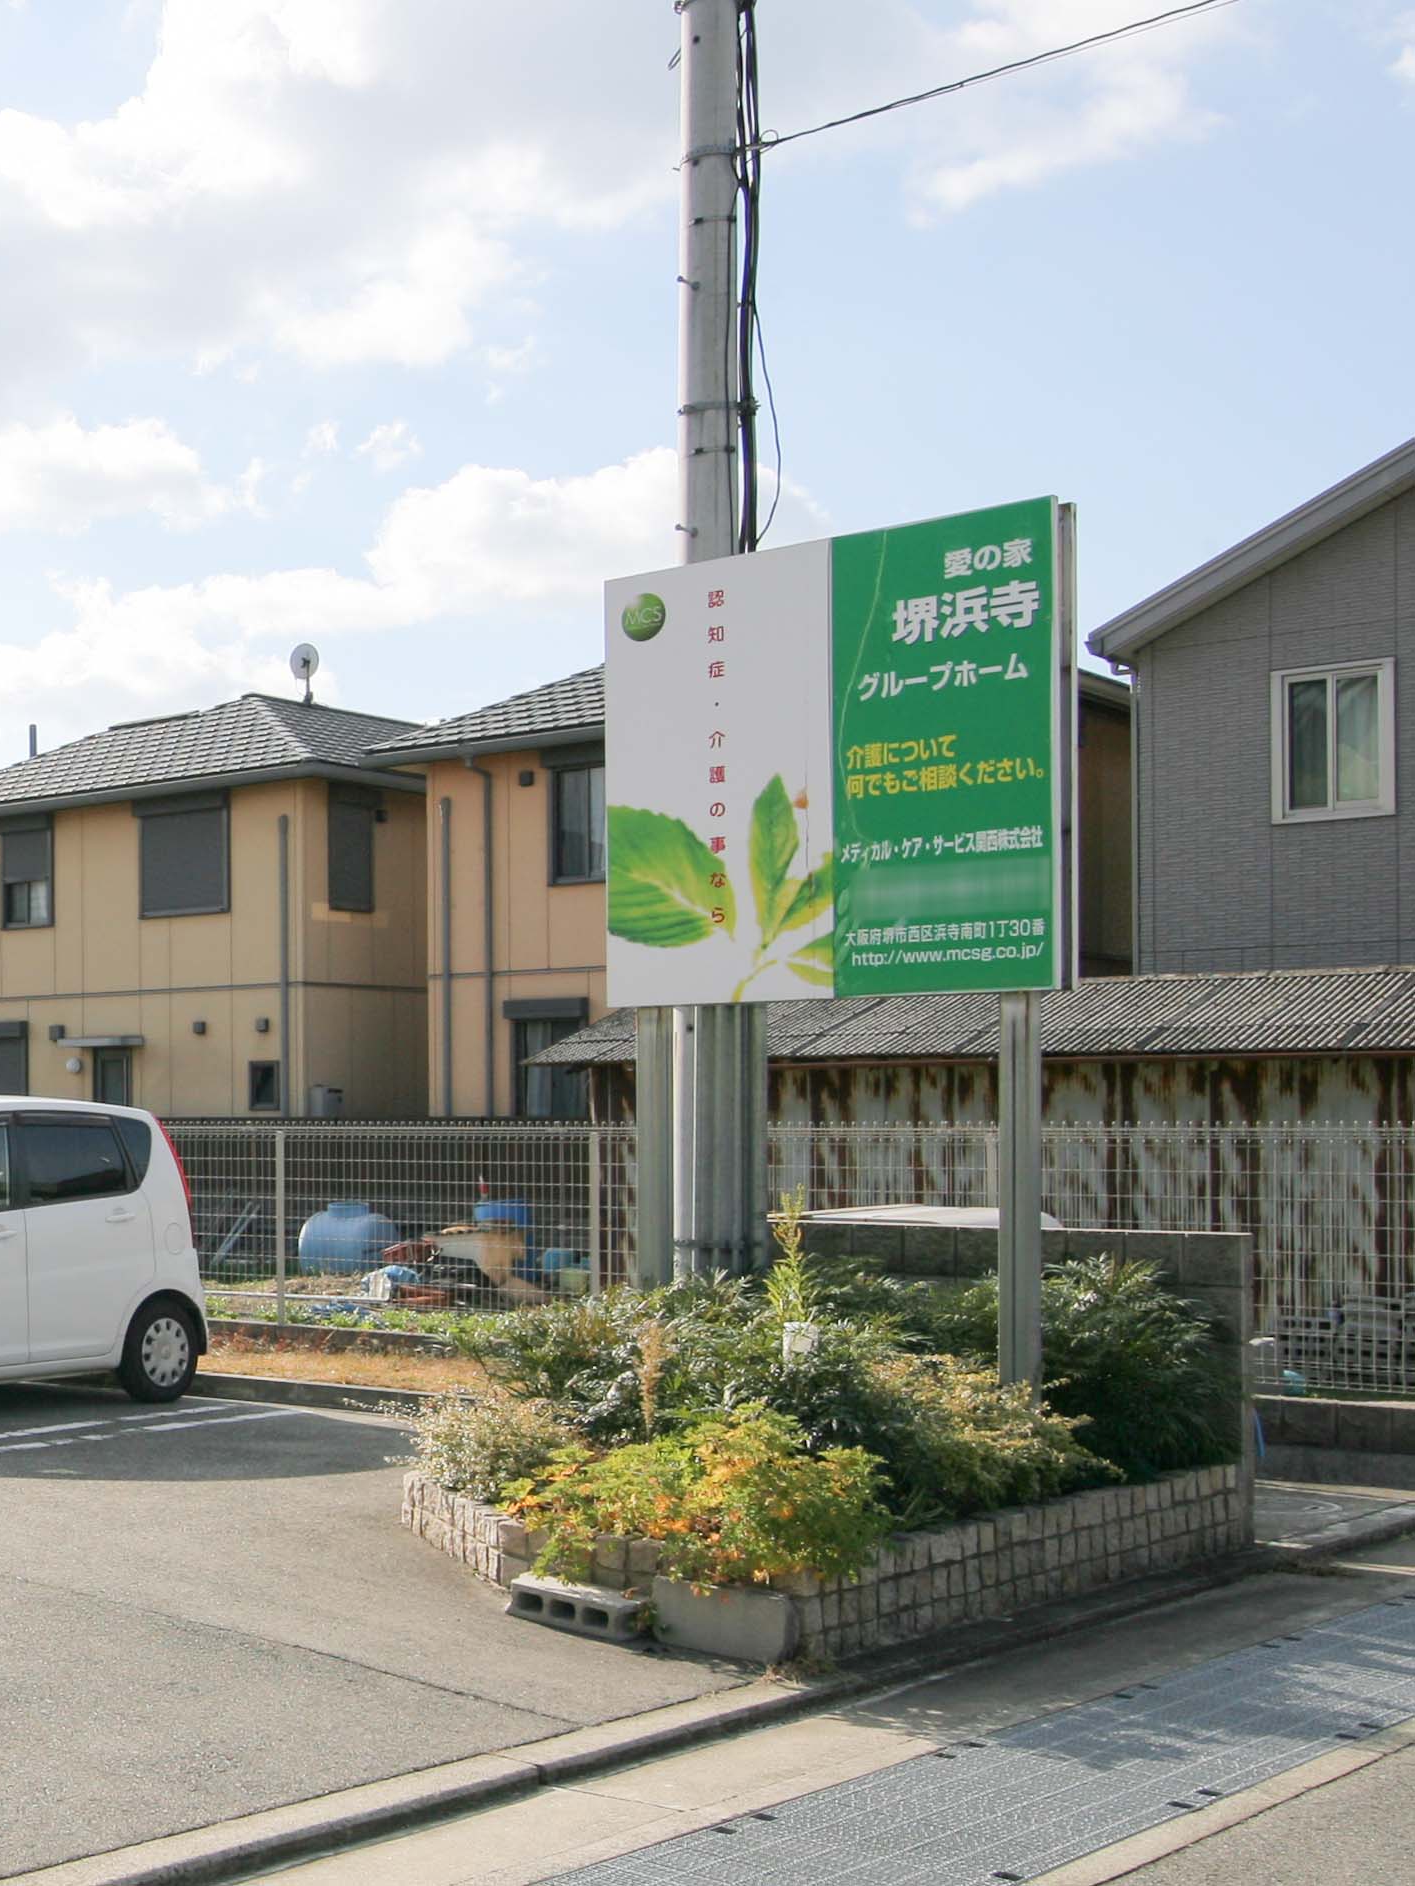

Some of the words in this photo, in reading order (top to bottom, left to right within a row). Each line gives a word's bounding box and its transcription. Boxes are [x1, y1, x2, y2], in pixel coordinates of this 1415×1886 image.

[944, 538, 1033, 579] 愛の家
[625, 606, 663, 626] MCS
[892, 580, 1040, 645] 堺浜寺
[857, 652, 1029, 702] グループホーム
[707, 589, 726, 923] 認知症・介護の事なら
[845, 734, 958, 770] 介護について
[846, 757, 1045, 799] 何でもご相談ください。
[851, 942, 1045, 967] http://www.mcsg.co.jp/
